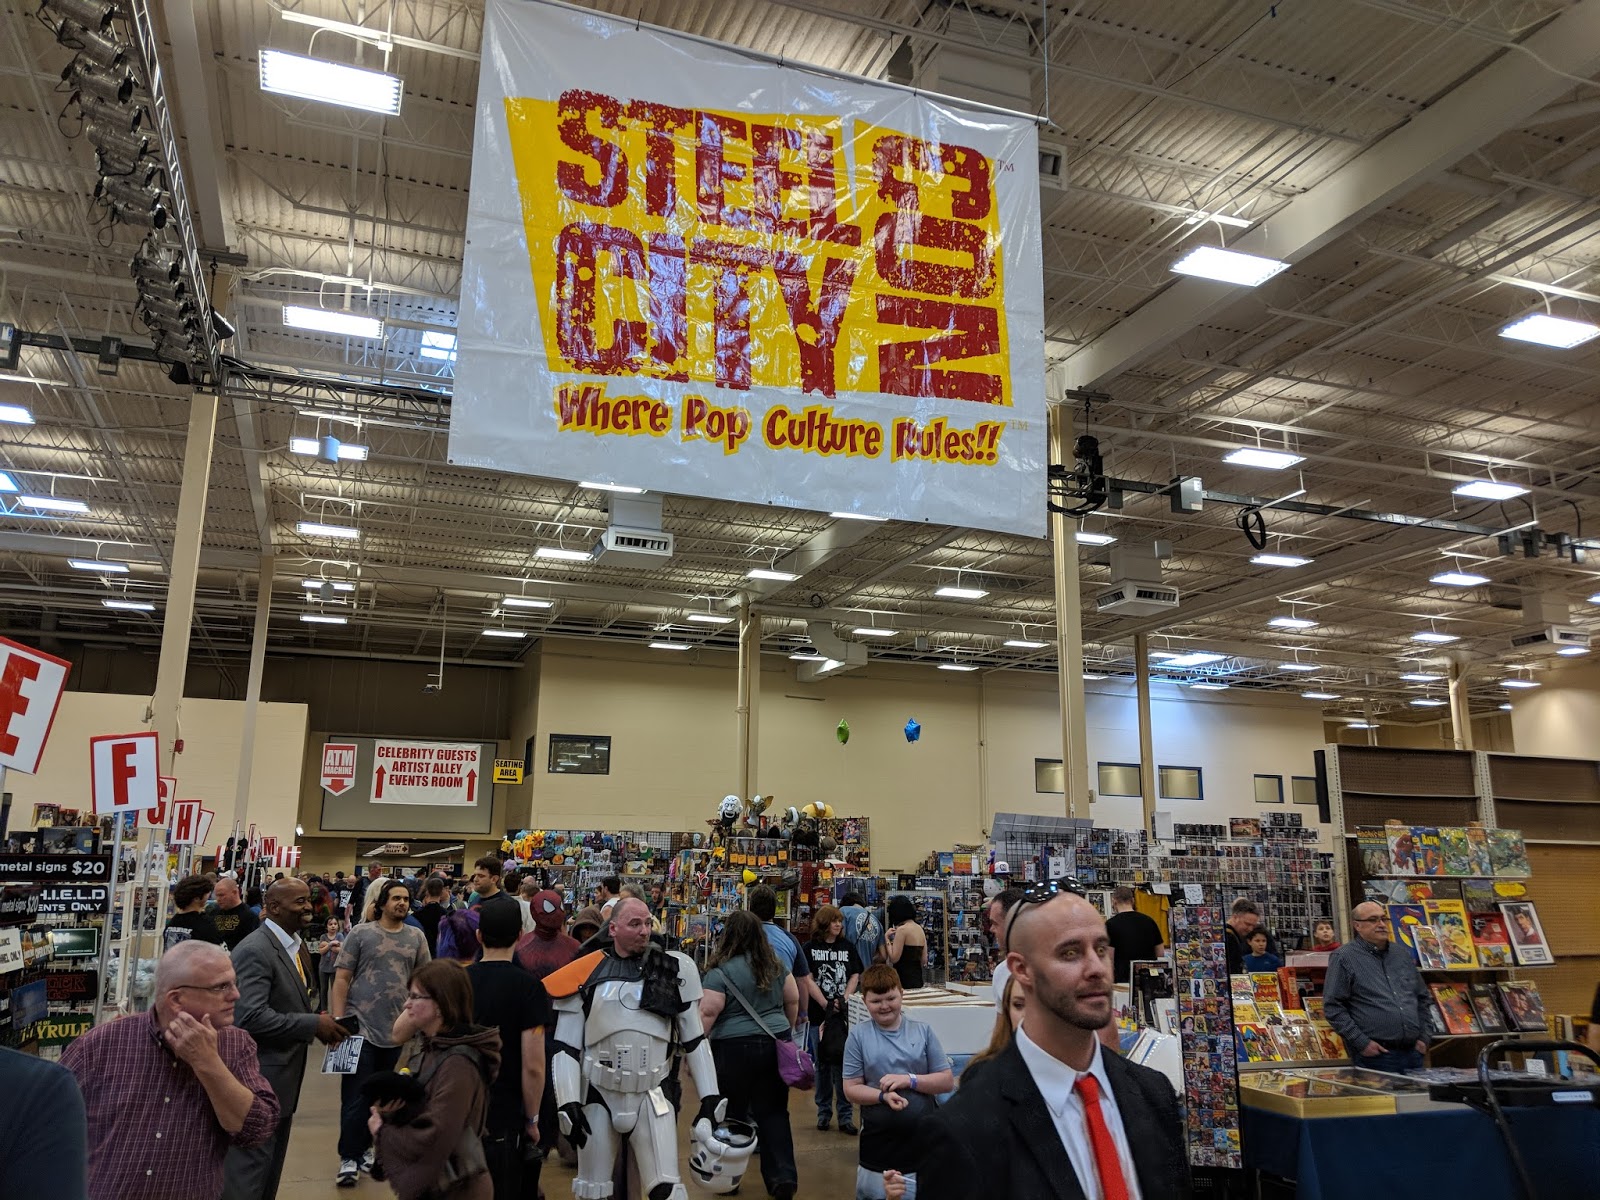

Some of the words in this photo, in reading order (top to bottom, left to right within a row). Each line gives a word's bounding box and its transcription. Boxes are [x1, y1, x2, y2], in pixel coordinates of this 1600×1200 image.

[556, 87, 861, 246] STEEL
[871, 134, 1003, 404] CON
[555, 221, 861, 399] CITY
[557, 384, 671, 433] Where
[684, 397, 749, 451] Pop
[766, 408, 882, 455] Culture
[895, 420, 1001, 461] Rules!!
[0, 652, 41, 757] E
[325, 749, 354, 766] ATM
[378, 746, 435, 760] CELEBRITY
[437, 749, 477, 762] GUESTS
[324, 766, 353, 775] MACHINE
[392, 761, 431, 774] ARTIST
[433, 763, 463, 775] ALLEY
[495, 760, 523, 769] SEATING
[111, 741, 137, 806] F
[389, 774, 429, 787] EVENTS
[431, 776, 463, 788] ROOM
[176, 804, 193, 840] H
[264, 839, 275, 856] M
[35, 861, 67, 873] signs
[71, 860, 105, 876] $20
[1, 900, 15, 913] metal
[38, 903, 66, 912] ENTS
[71, 902, 102, 911] ONLY
[811, 948, 830, 961] FIGHT
[829, 950, 838, 961] OR
[838, 950, 849, 962] DIE
